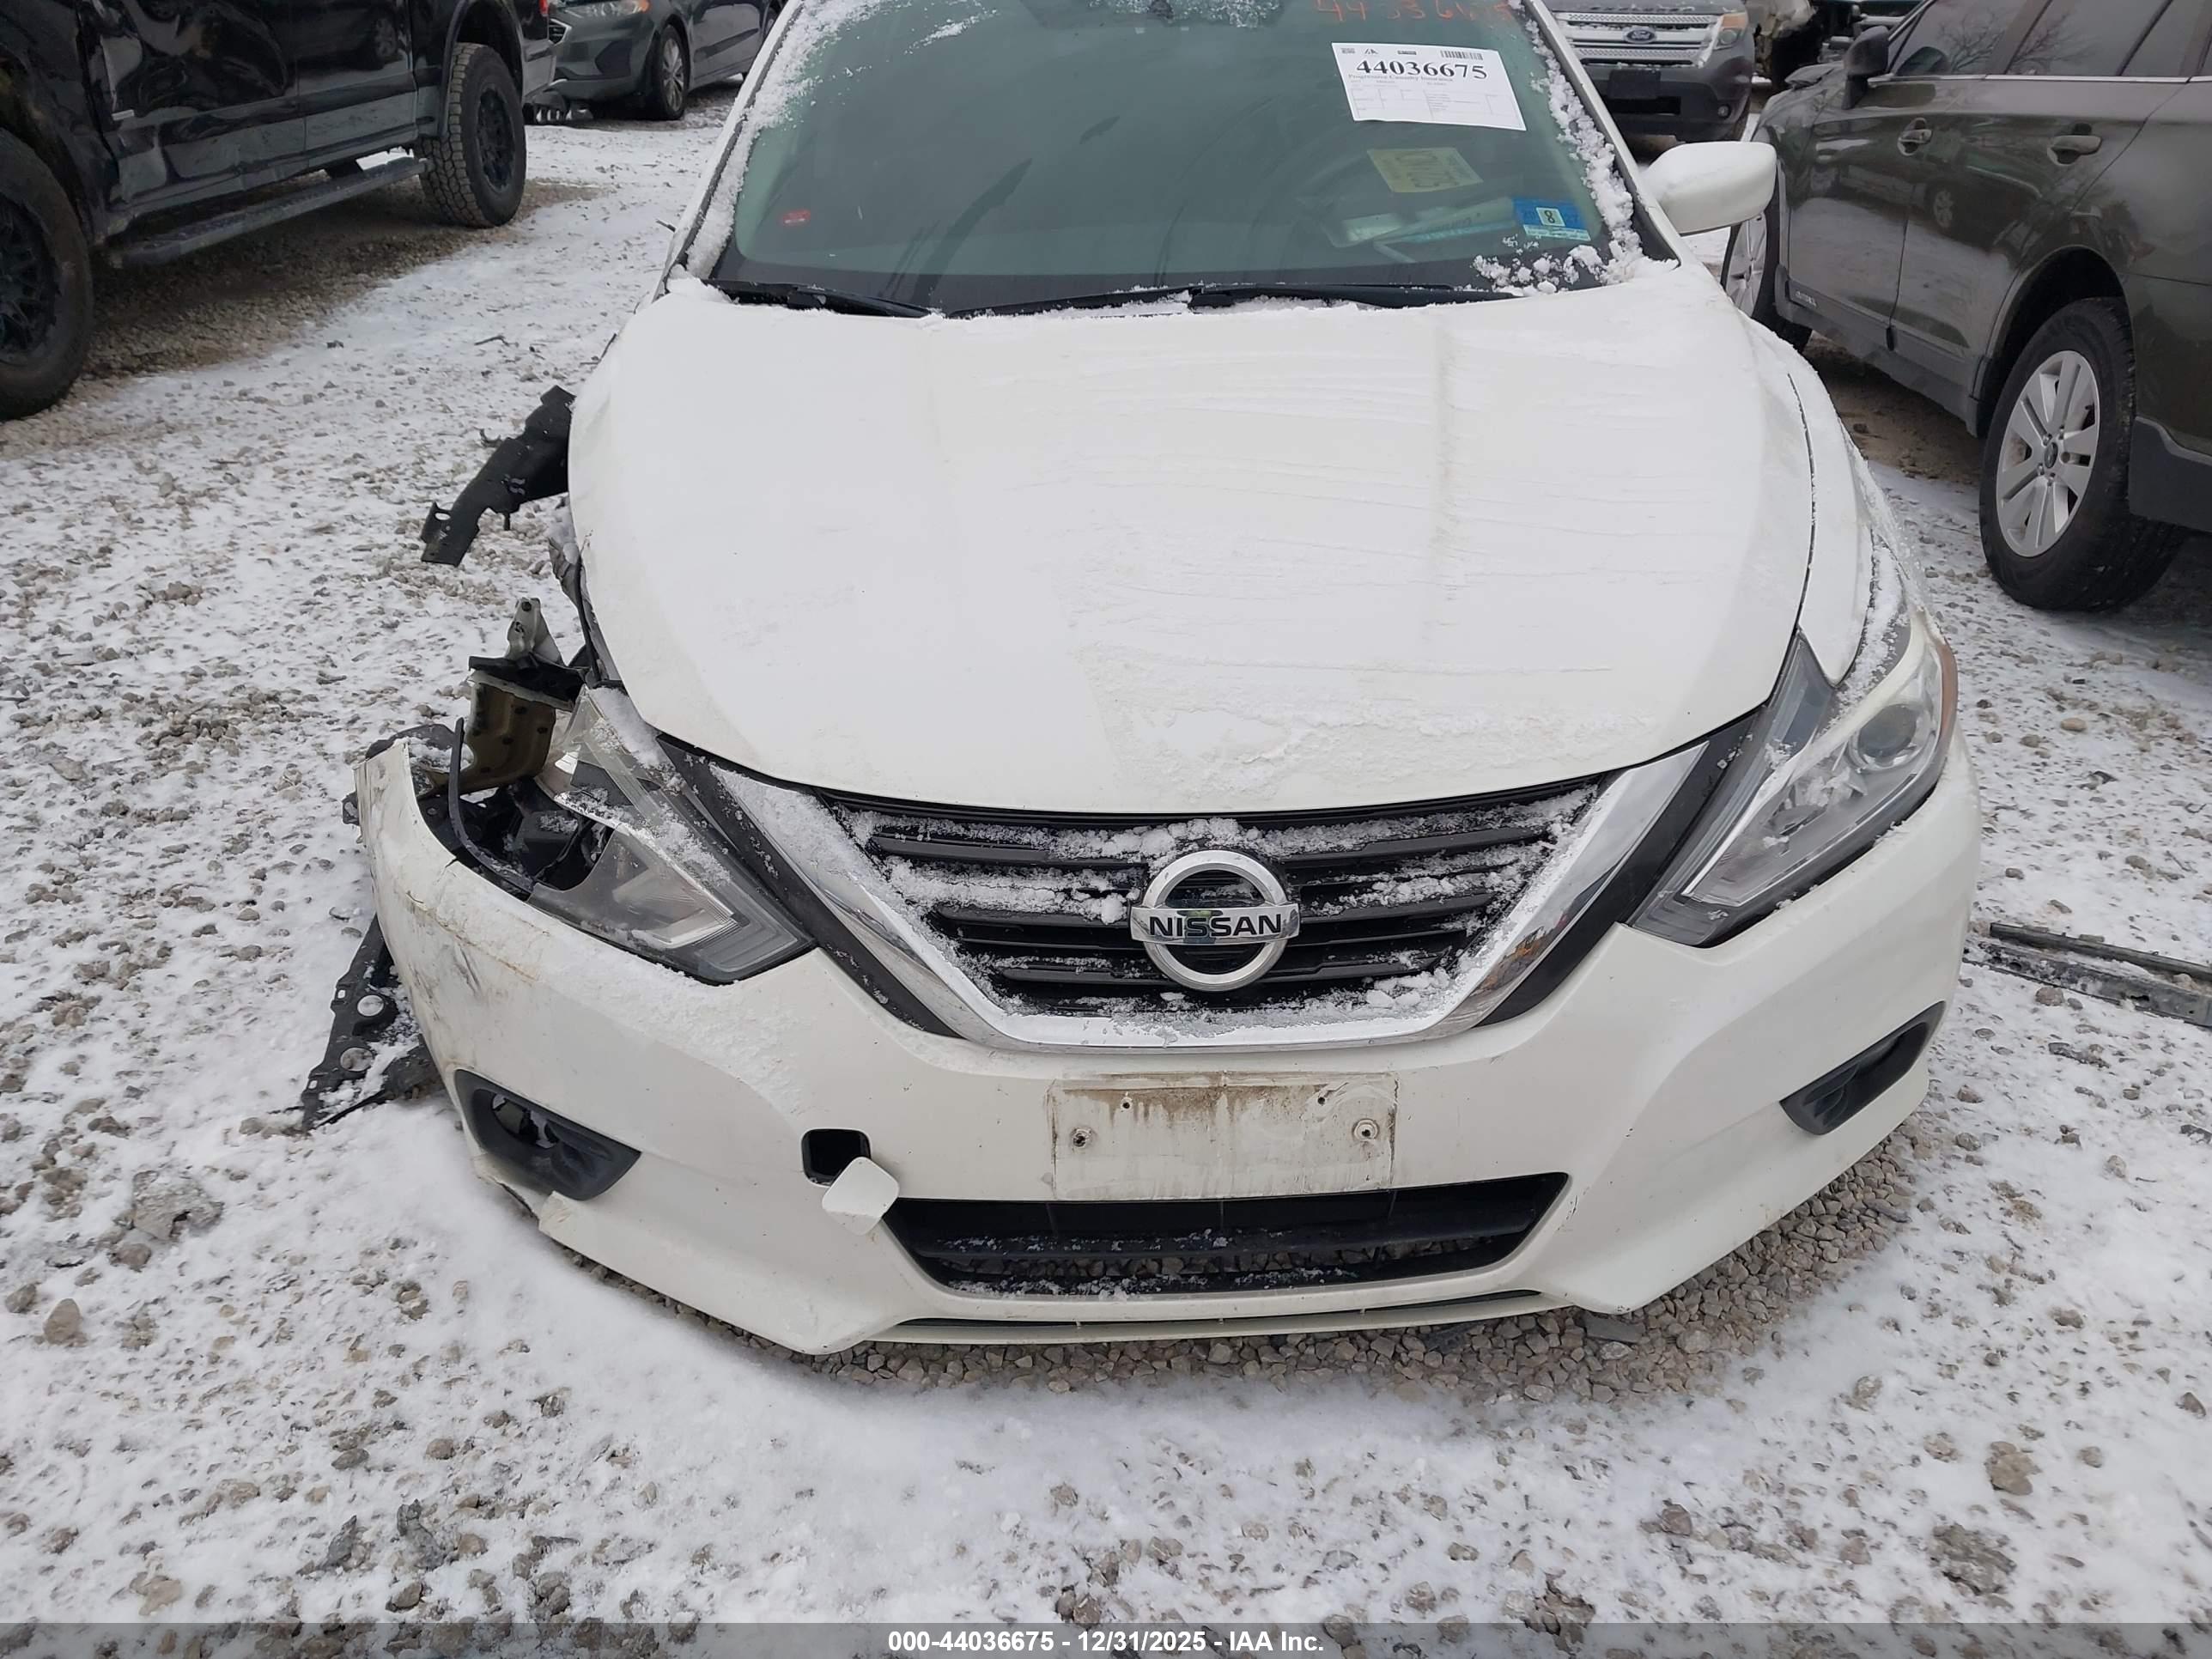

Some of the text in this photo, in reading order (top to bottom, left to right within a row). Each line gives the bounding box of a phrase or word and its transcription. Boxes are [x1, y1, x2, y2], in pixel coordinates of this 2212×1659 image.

[1357, 59, 1487, 80] 44036675
[1544, 210, 1556, 224] 8
[1149, 914, 1282, 937] NISSAN
